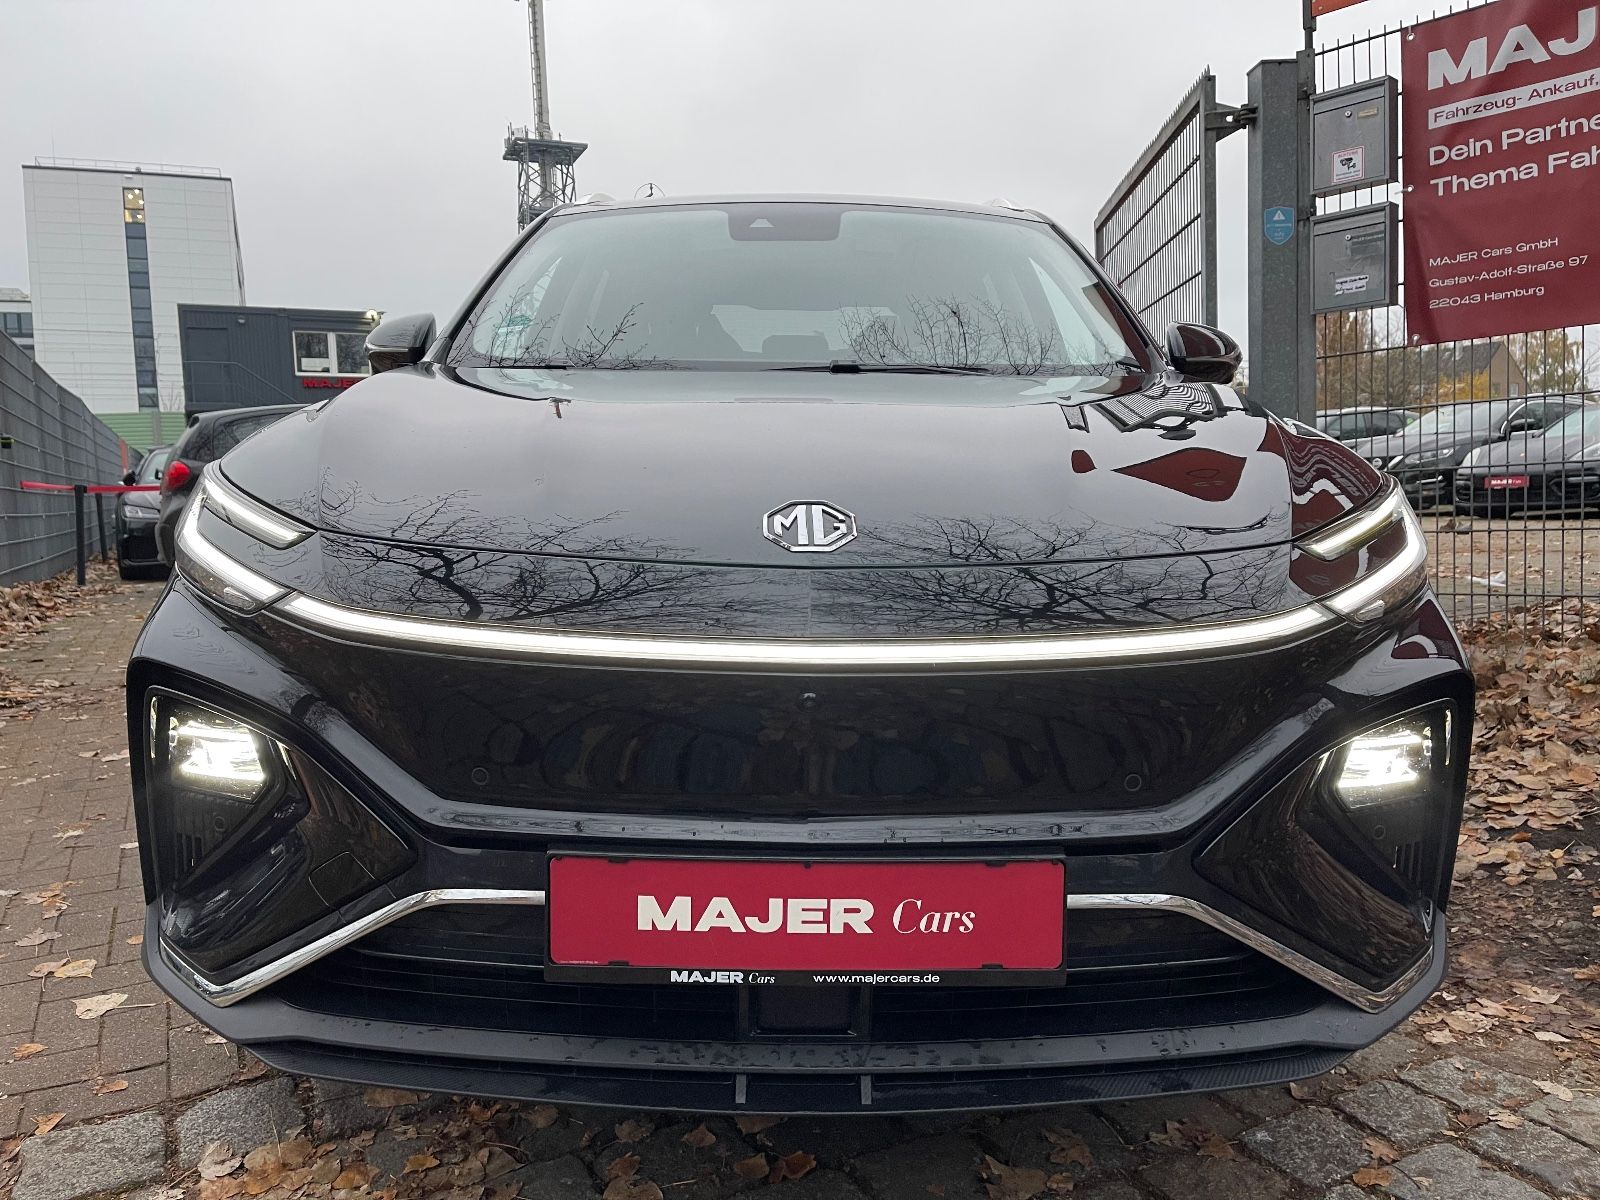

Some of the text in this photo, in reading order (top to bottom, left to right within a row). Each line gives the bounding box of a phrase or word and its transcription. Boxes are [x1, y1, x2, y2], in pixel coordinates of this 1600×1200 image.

[1428, 6, 1597, 91] MAJ
[1433, 73, 1599, 124] Fahrzeug- Ankauf,
[1429, 138, 1493, 167] Dein
[1430, 162, 1539, 197] Thema
[1429, 237, 1559, 267] MAJER Cars GmbH
[1429, 254, 1588, 288] Gustav-Adolf-Straße 97
[1429, 286, 1545, 309] 22043 Hamburg
[303, 377, 362, 388] MAJE
[773, 504, 848, 546] MG
[637, 895, 976, 934] MAJER Cars
[670, 970, 940, 985] MAJER Cars www.majercars.de
